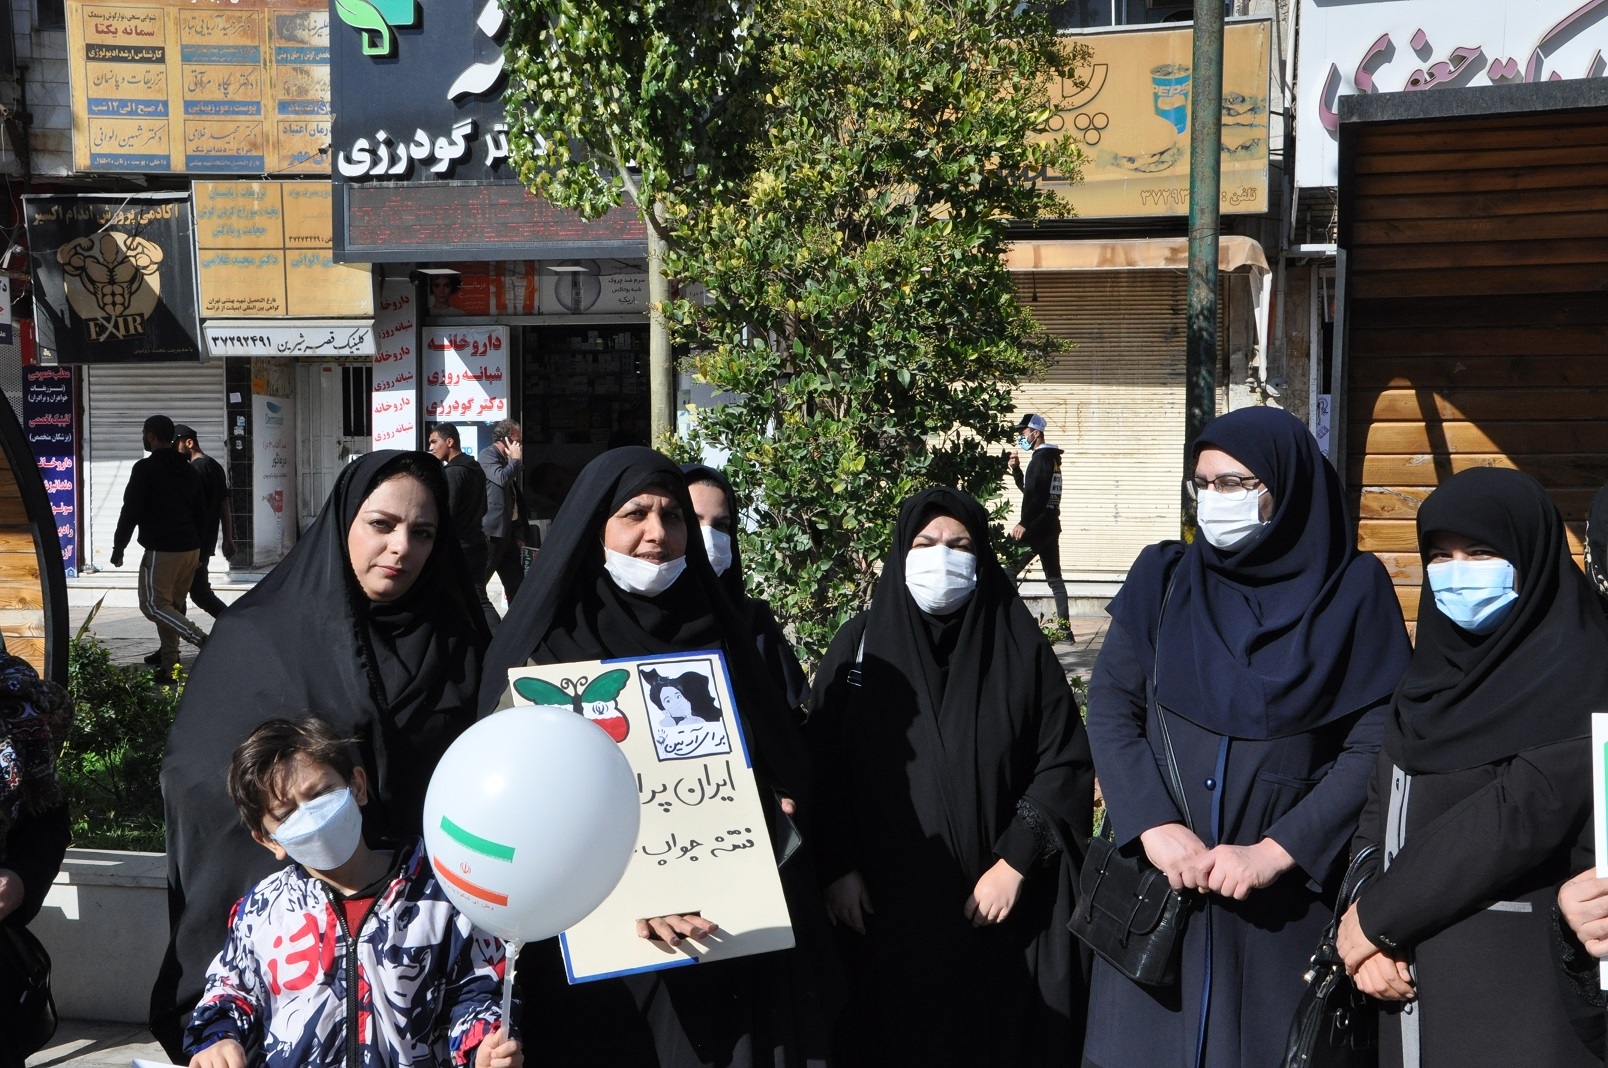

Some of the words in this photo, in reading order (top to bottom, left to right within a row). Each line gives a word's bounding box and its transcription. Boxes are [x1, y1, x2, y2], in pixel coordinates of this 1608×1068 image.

[95, 23, 118, 38] یکتا
[122, 25, 154, 36] سمانه
[182, 16, 196, 35] تبار
[195, 14, 225, 36] آریایی
[220, 20, 236, 36] حمید
[231, 12, 254, 35] دکتر
[88, 48, 118, 58] ادیولوژی
[120, 50, 134, 59] ارشد
[135, 50, 162, 60] کارشناس
[93, 70, 119, 90] پانسمان
[127, 70, 164, 89] تزریقات
[233, 68, 256, 95] دکتر
[92, 102, 107, 112] شب
[109, 101, 118, 111] ۱۲
[120, 102, 135, 113] الی
[138, 105, 155, 114] صبح
[158, 102, 164, 112] ۸
[94, 127, 117, 146] الوانی
[118, 125, 142, 147] شهین
[141, 124, 166, 147] دکتر
[188, 127, 206, 142] غلامی
[208, 125, 240, 144] مجید
[240, 122, 260, 143] دکتر
[283, 123, 307, 136] اعتیاد
[309, 123, 331, 137] رمان
[337, 118, 475, 177] گودرزی
[1140, 188, 1190, 205] ۳۷۲۹۳
[33, 205, 62, 225] اکسیر
[66, 206, 93, 224] اندام
[203, 253, 229, 268] غلامی
[232, 256, 255, 268] مجید
[257, 254, 279, 269] دکتر
[381, 295, 410, 311] داروخا
[87, 314, 144, 342] EXIR
[395, 320, 413, 332] شبانه
[277, 333, 305, 353] شیرین
[304, 331, 334, 352] قصر
[333, 328, 369, 353] کلینیک
[427, 333, 502, 356] داروخانه
[374, 346, 410, 363] داروخانه
[28, 370, 52, 381] عمومی
[53, 368, 70, 380] مطب
[395, 372, 414, 383] شبانه
[427, 370, 460, 386] روزی
[462, 366, 502, 385] شبانه
[374, 380, 394, 392] روزی
[375, 397, 410, 413] داروخانه
[426, 397, 474, 416] گودرزی
[477, 396, 504, 416] دکتر
[29, 414, 52, 427] تخصصی
[52, 414, 71, 427] کلینیک
[395, 422, 414, 433] شبانه
[375, 430, 394, 442] روزی
[37, 456, 72, 470] داروخان
[664, 726, 703, 753] آرتین
[674, 732, 726, 756] برای
[674, 760, 736, 806] ایران
[642, 833, 704, 866] جواب
[711, 828, 754, 857] فتنه
